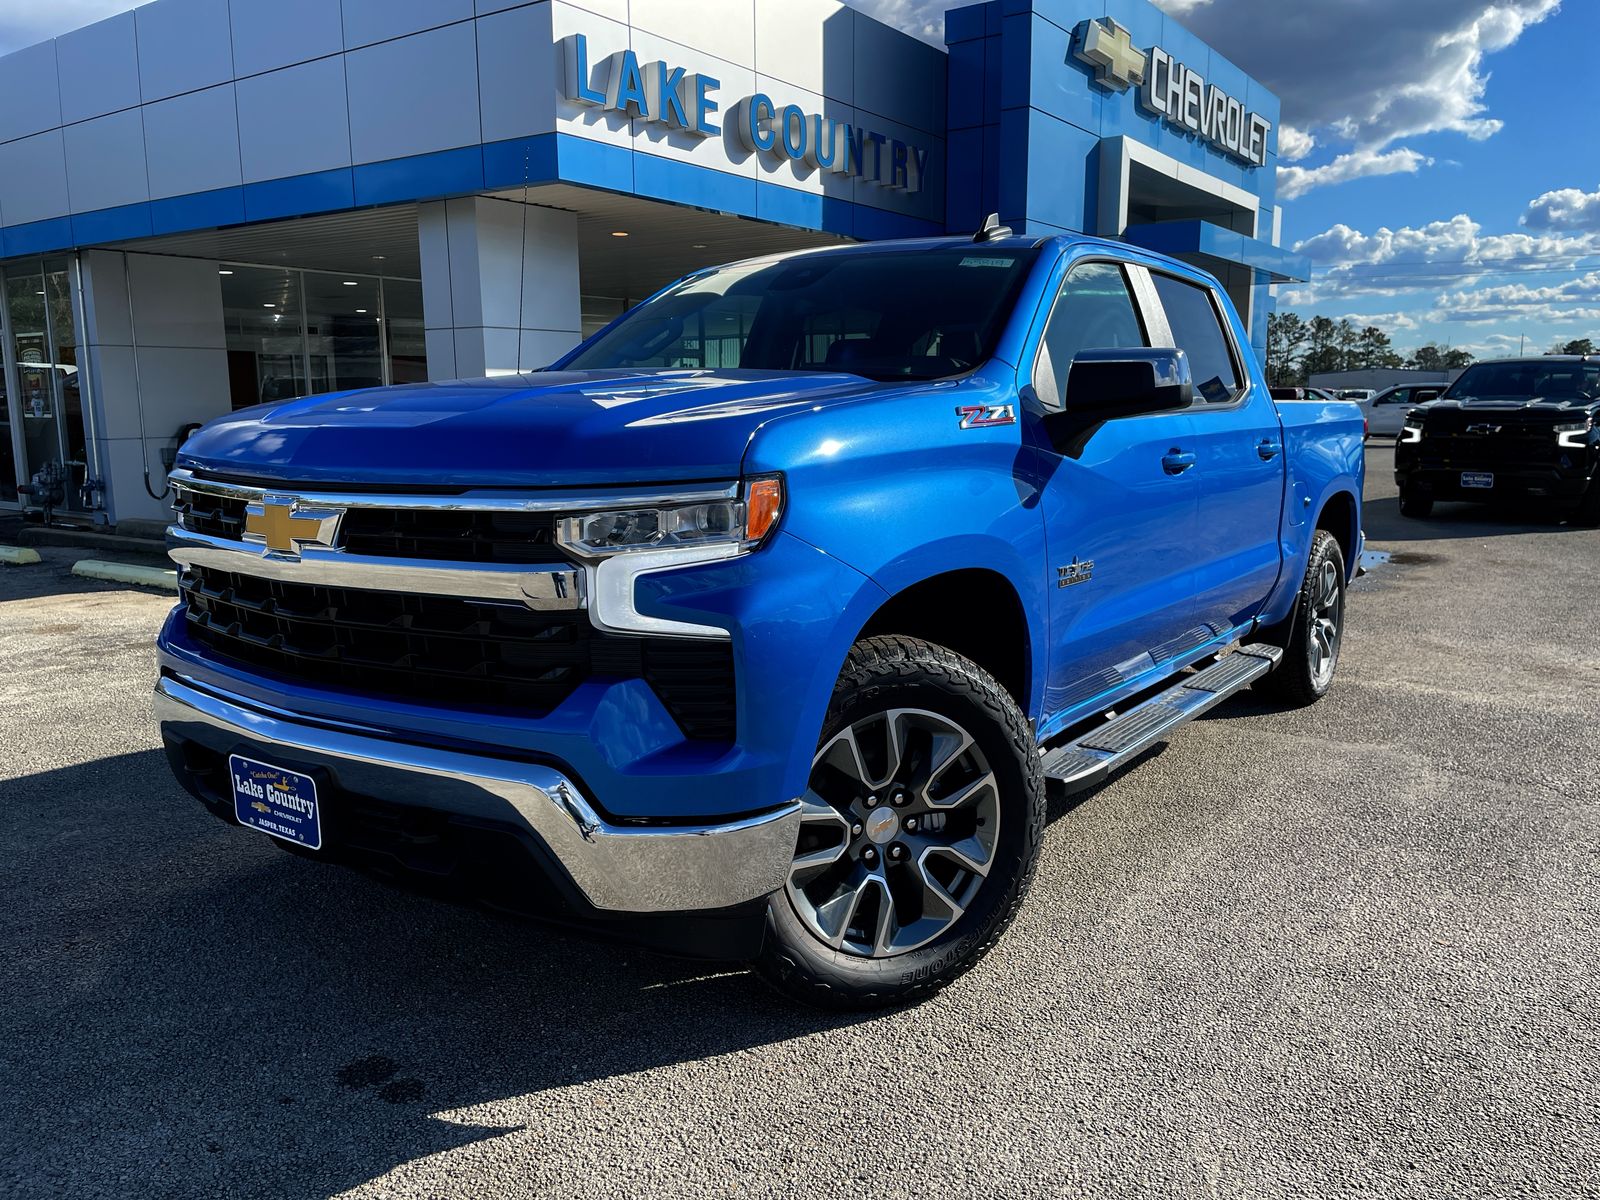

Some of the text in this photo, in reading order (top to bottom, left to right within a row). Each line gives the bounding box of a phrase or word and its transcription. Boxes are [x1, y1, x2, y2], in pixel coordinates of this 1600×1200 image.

[568, 33, 929, 193] LAKE COUNTRY
[1150, 45, 1272, 168] CHEVROLET
[955, 404, 1017, 430] Z71
[235, 774, 314, 819] Lake Country
[258, 818, 296, 836] JASPER, TEXAS
[273, 810, 302, 823] CHEVROLET
